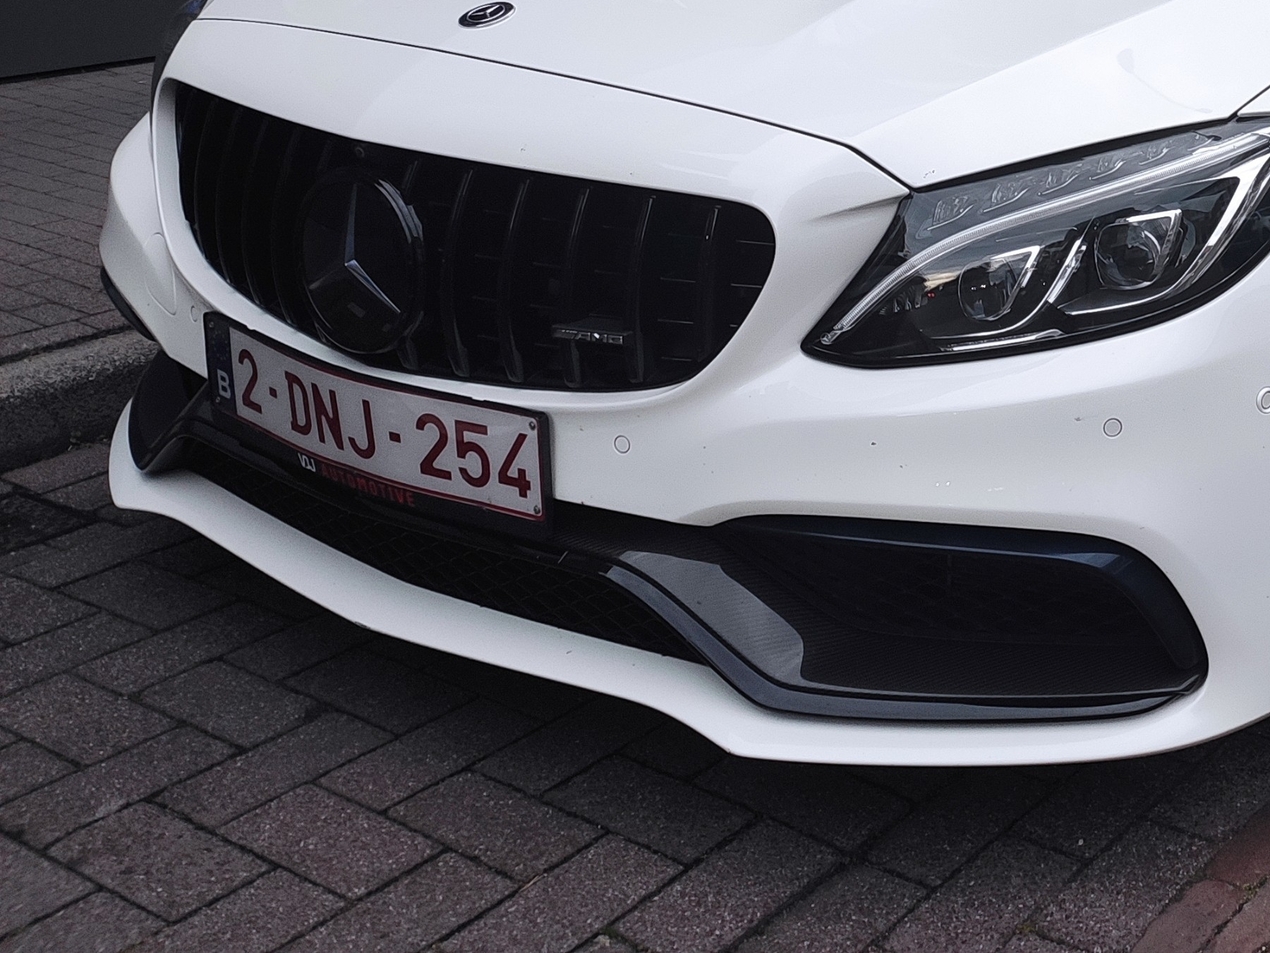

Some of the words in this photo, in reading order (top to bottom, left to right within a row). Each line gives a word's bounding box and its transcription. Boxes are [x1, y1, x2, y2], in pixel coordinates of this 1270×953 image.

[216, 368, 232, 399] B
[238, 348, 531, 498] 2-DNJ-254
[321, 462, 415, 508] AUTOMOTIVE
